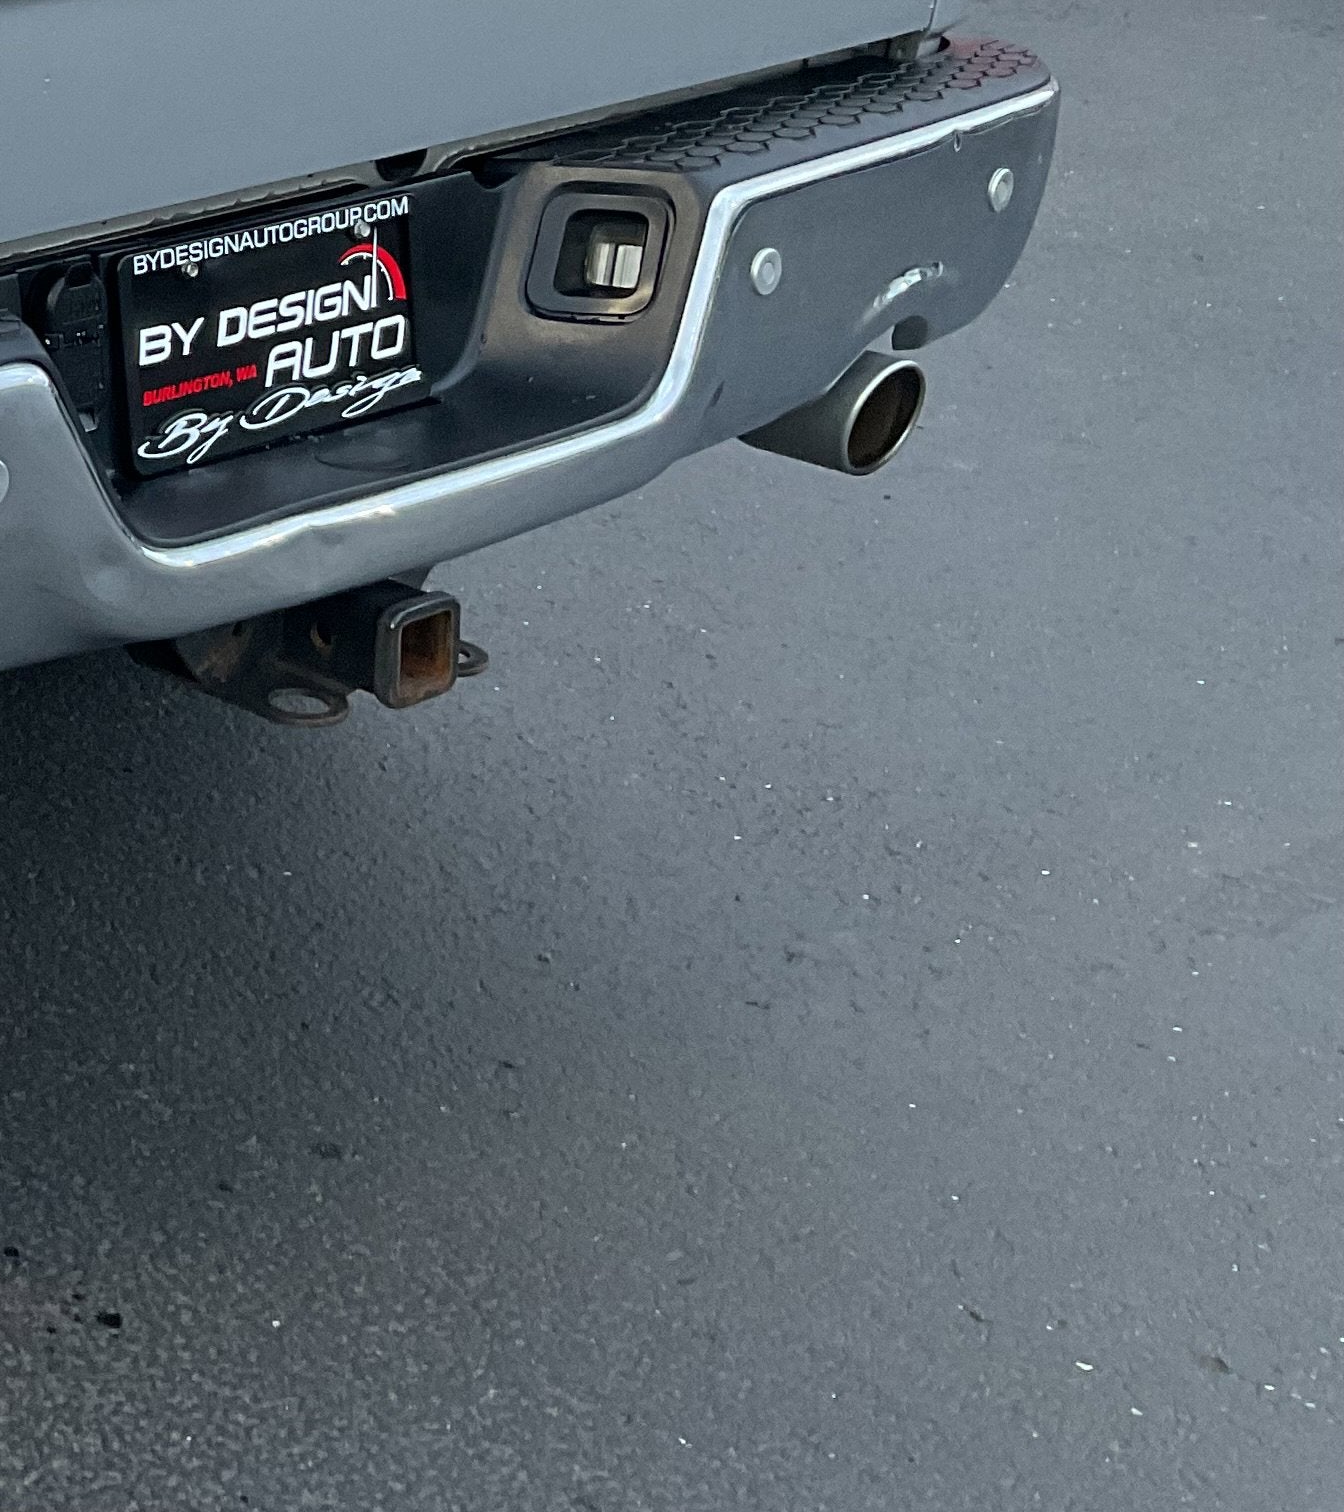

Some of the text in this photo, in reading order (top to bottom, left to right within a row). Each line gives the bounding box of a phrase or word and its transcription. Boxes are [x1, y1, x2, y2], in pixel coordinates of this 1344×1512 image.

[133, 196, 410, 276] BYDESIGNAUTOGROUPCOM
[138, 275, 374, 367] BY DESIGN
[264, 314, 406, 388] AUTO
[142, 364, 258, 407] BURLINGTON, WA
[137, 411, 234, 465] By
